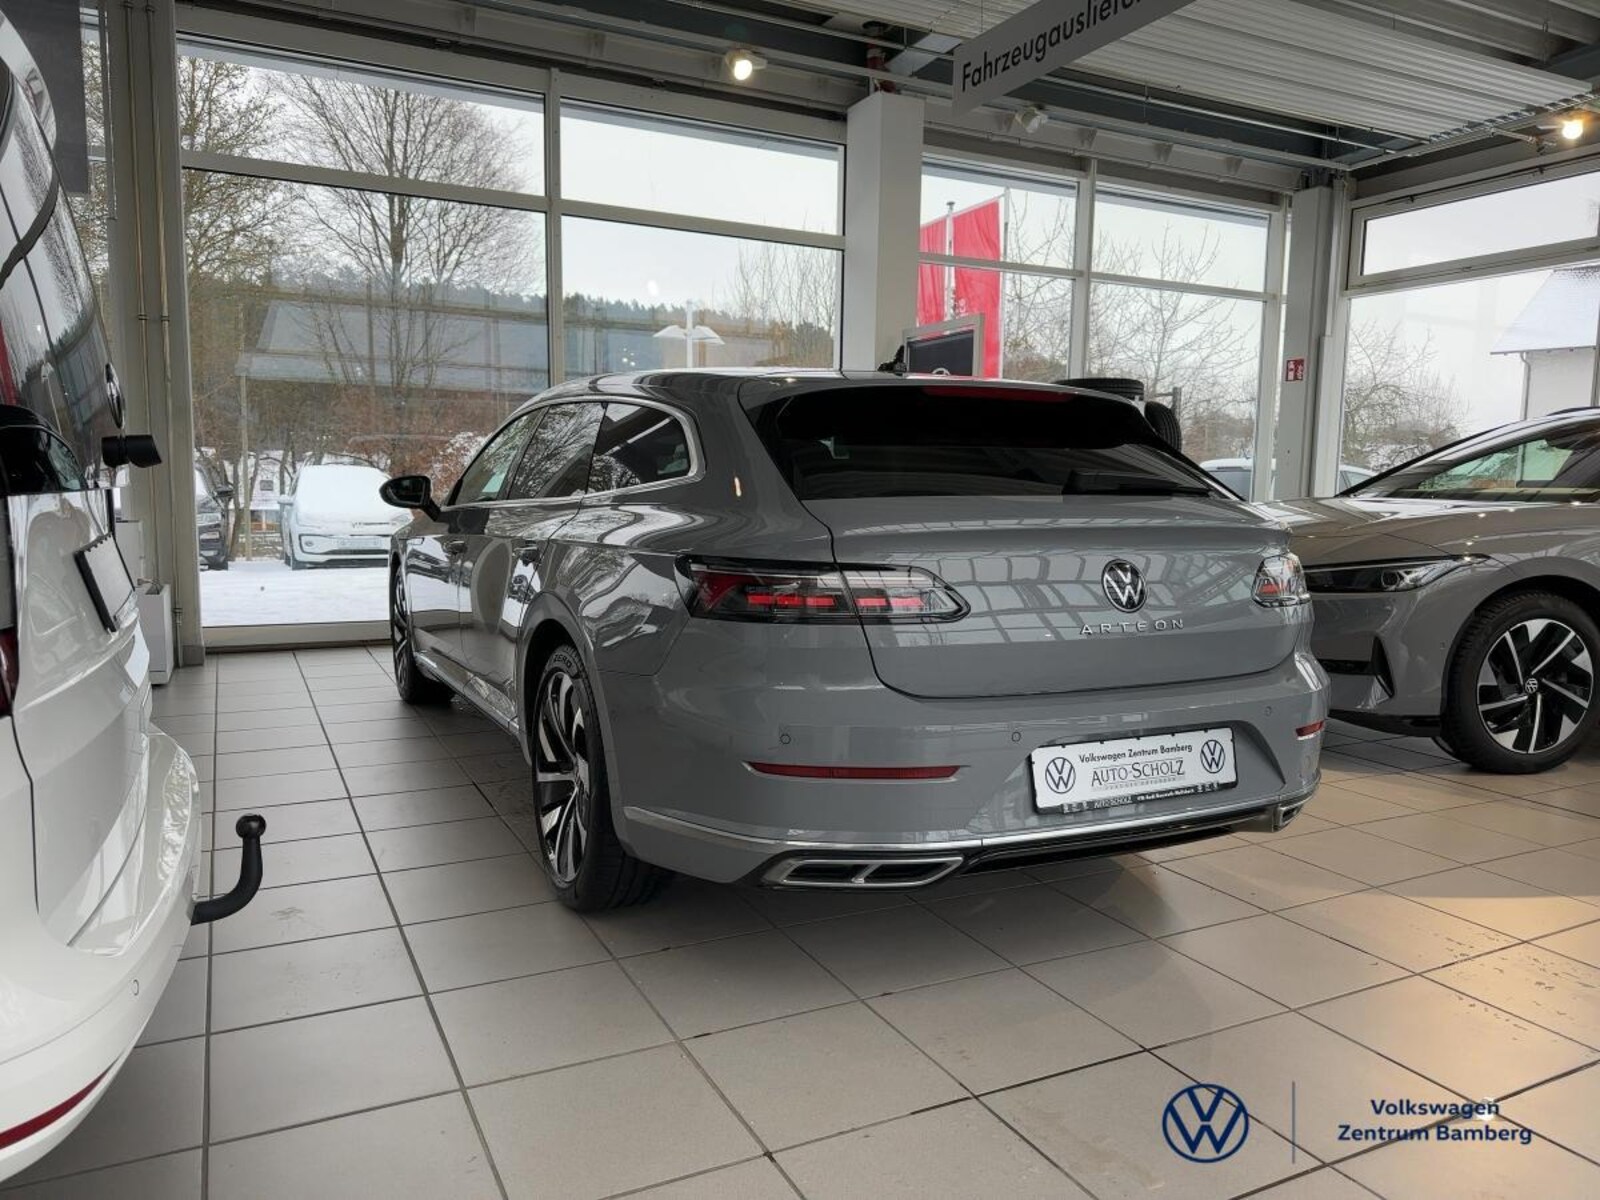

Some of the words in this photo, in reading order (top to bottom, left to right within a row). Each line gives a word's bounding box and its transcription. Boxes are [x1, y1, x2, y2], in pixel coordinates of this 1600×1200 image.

[1080, 619, 1184, 635] ARTEON
[1079, 753, 1126, 764] Volkswagen
[1128, 748, 1159, 759] Zentrum
[1160, 744, 1193, 755] Bamberg
